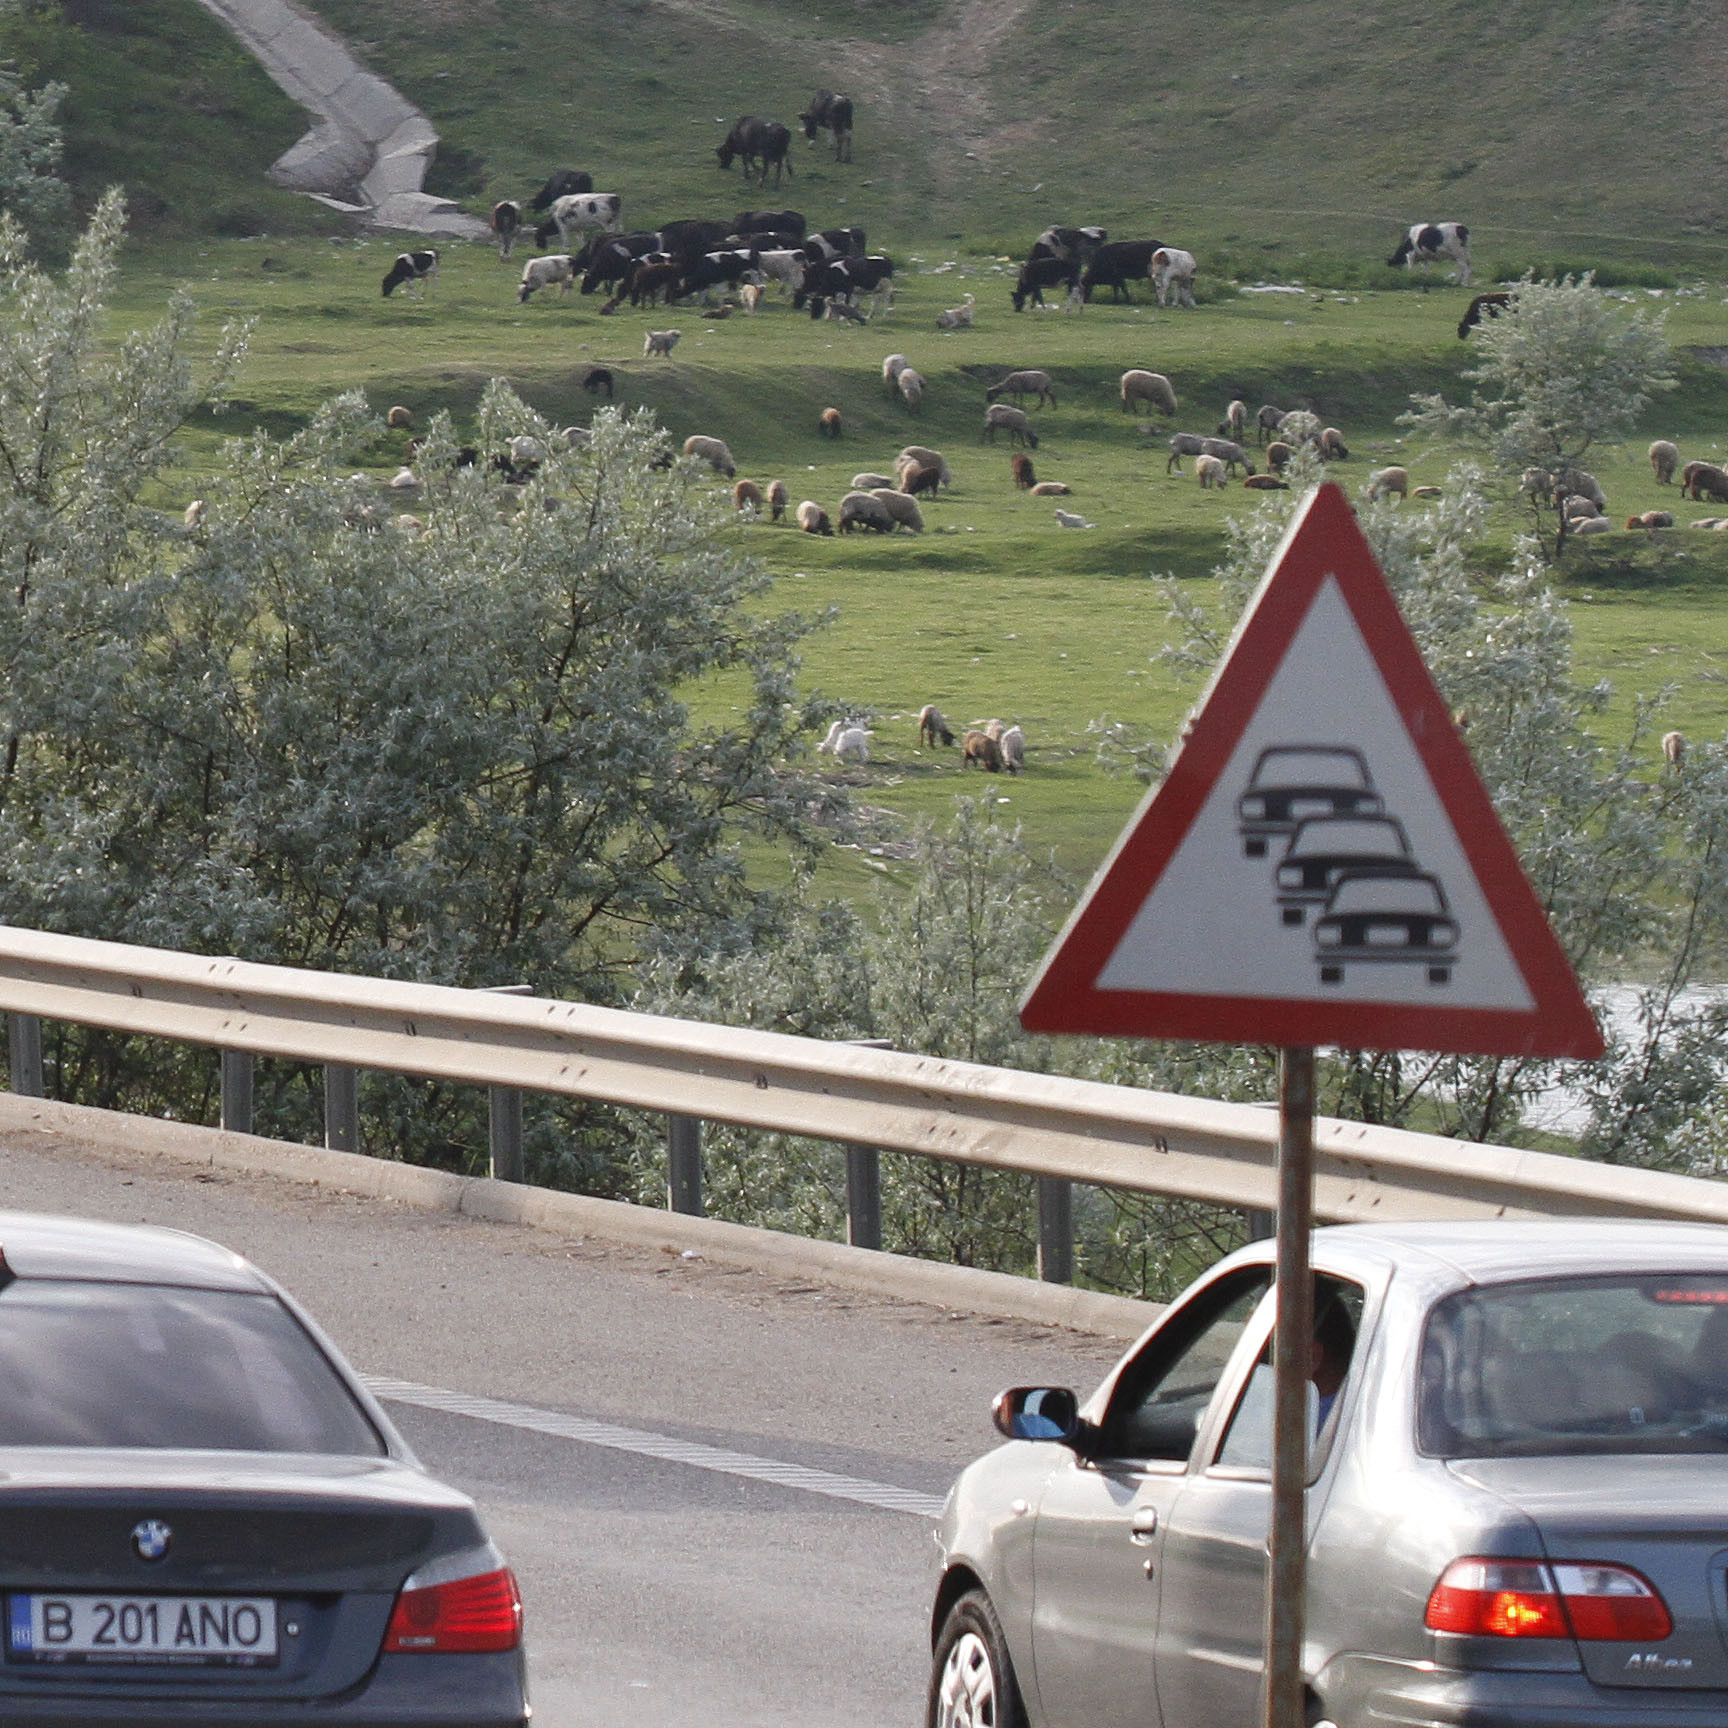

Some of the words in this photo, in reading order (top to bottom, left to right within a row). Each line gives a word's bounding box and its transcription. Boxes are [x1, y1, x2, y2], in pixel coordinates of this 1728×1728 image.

[43, 1601, 73, 1643] B
[93, 1602, 160, 1646] 201
[174, 1602, 262, 1647] ANO
